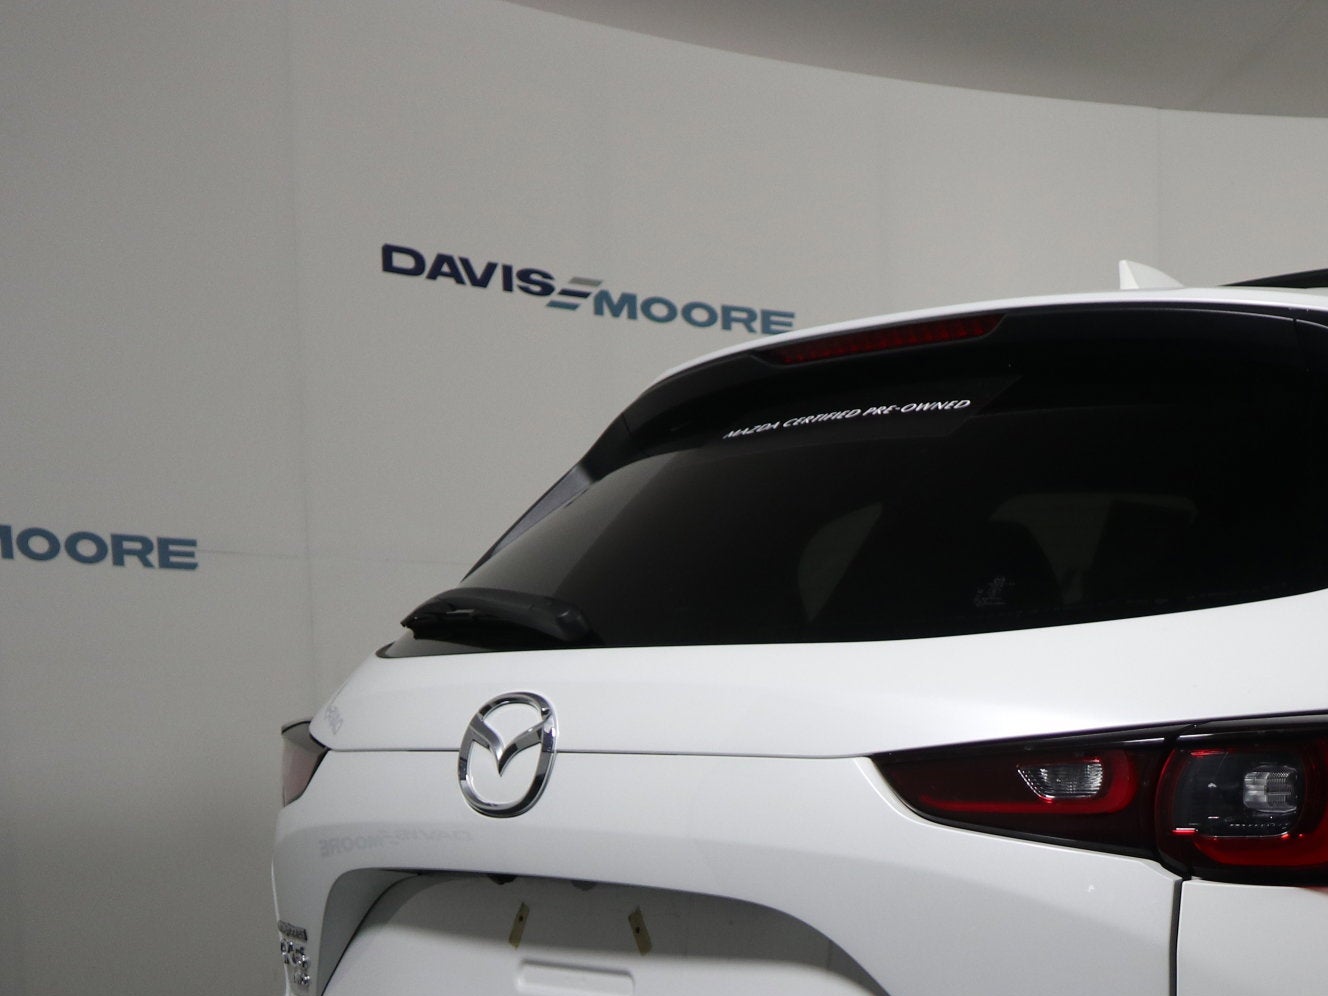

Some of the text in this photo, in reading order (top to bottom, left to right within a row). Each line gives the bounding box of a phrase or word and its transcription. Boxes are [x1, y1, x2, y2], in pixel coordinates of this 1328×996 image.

[381, 243, 796, 336] DAVIS MOORE
[722, 399, 971, 439] MAZDA CERTIFIED PRE-OWNED
